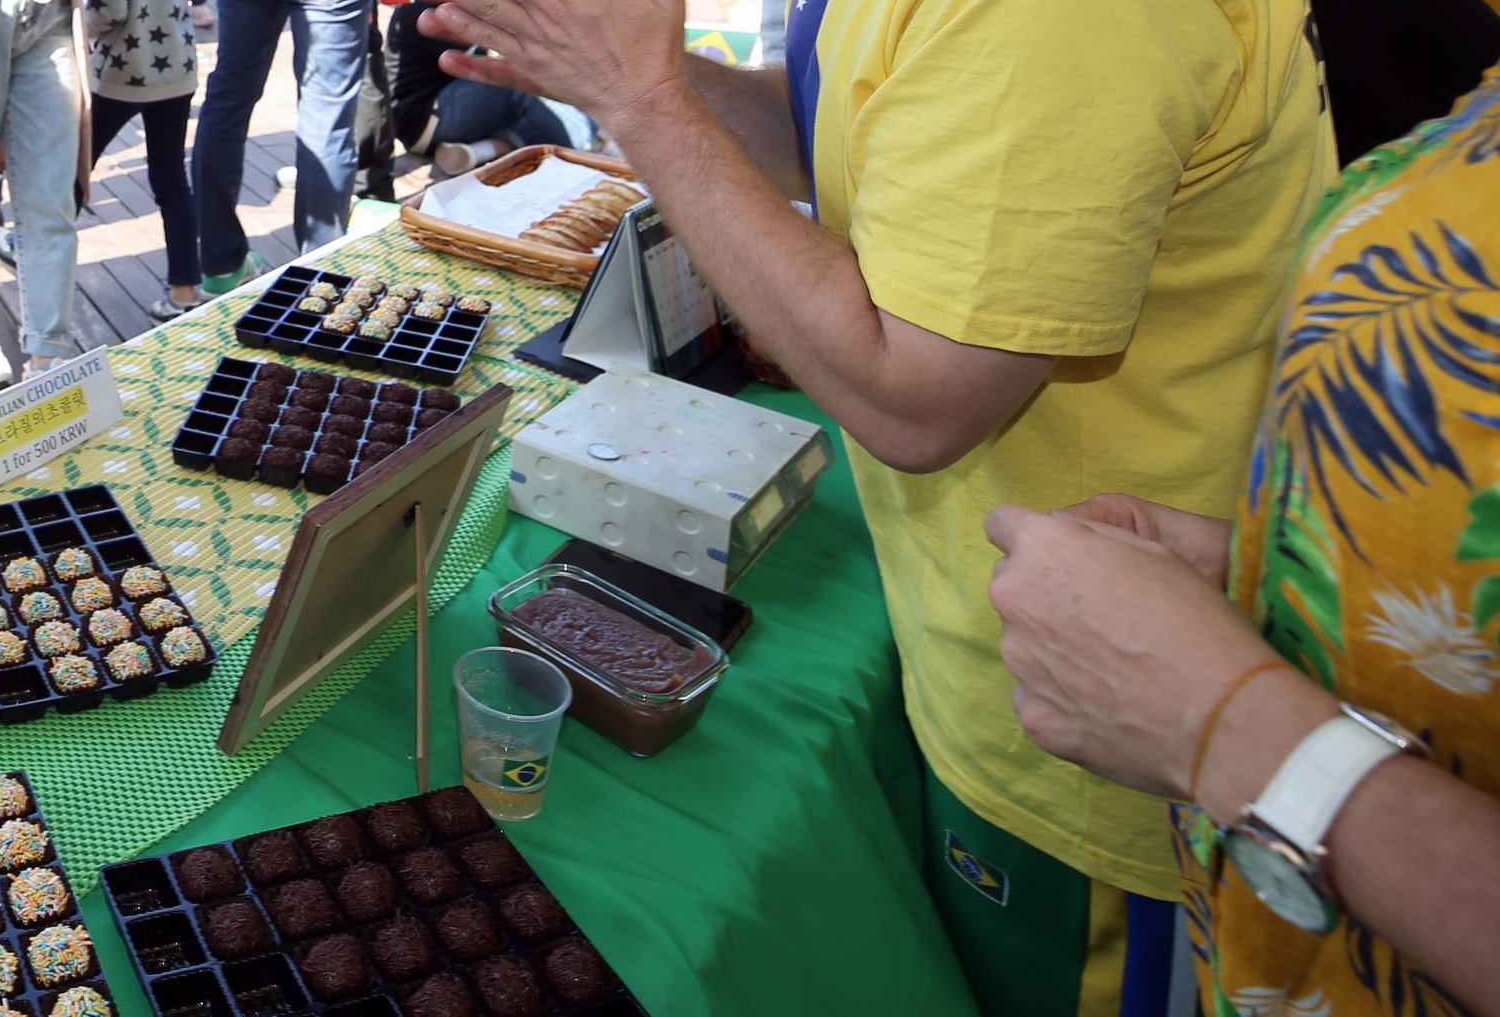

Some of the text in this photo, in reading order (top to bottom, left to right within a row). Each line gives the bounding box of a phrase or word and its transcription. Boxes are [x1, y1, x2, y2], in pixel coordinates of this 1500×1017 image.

[26, 357, 103, 404] CHOCOLATE
[2, 419, 89, 474] 1 for 500 KRW
